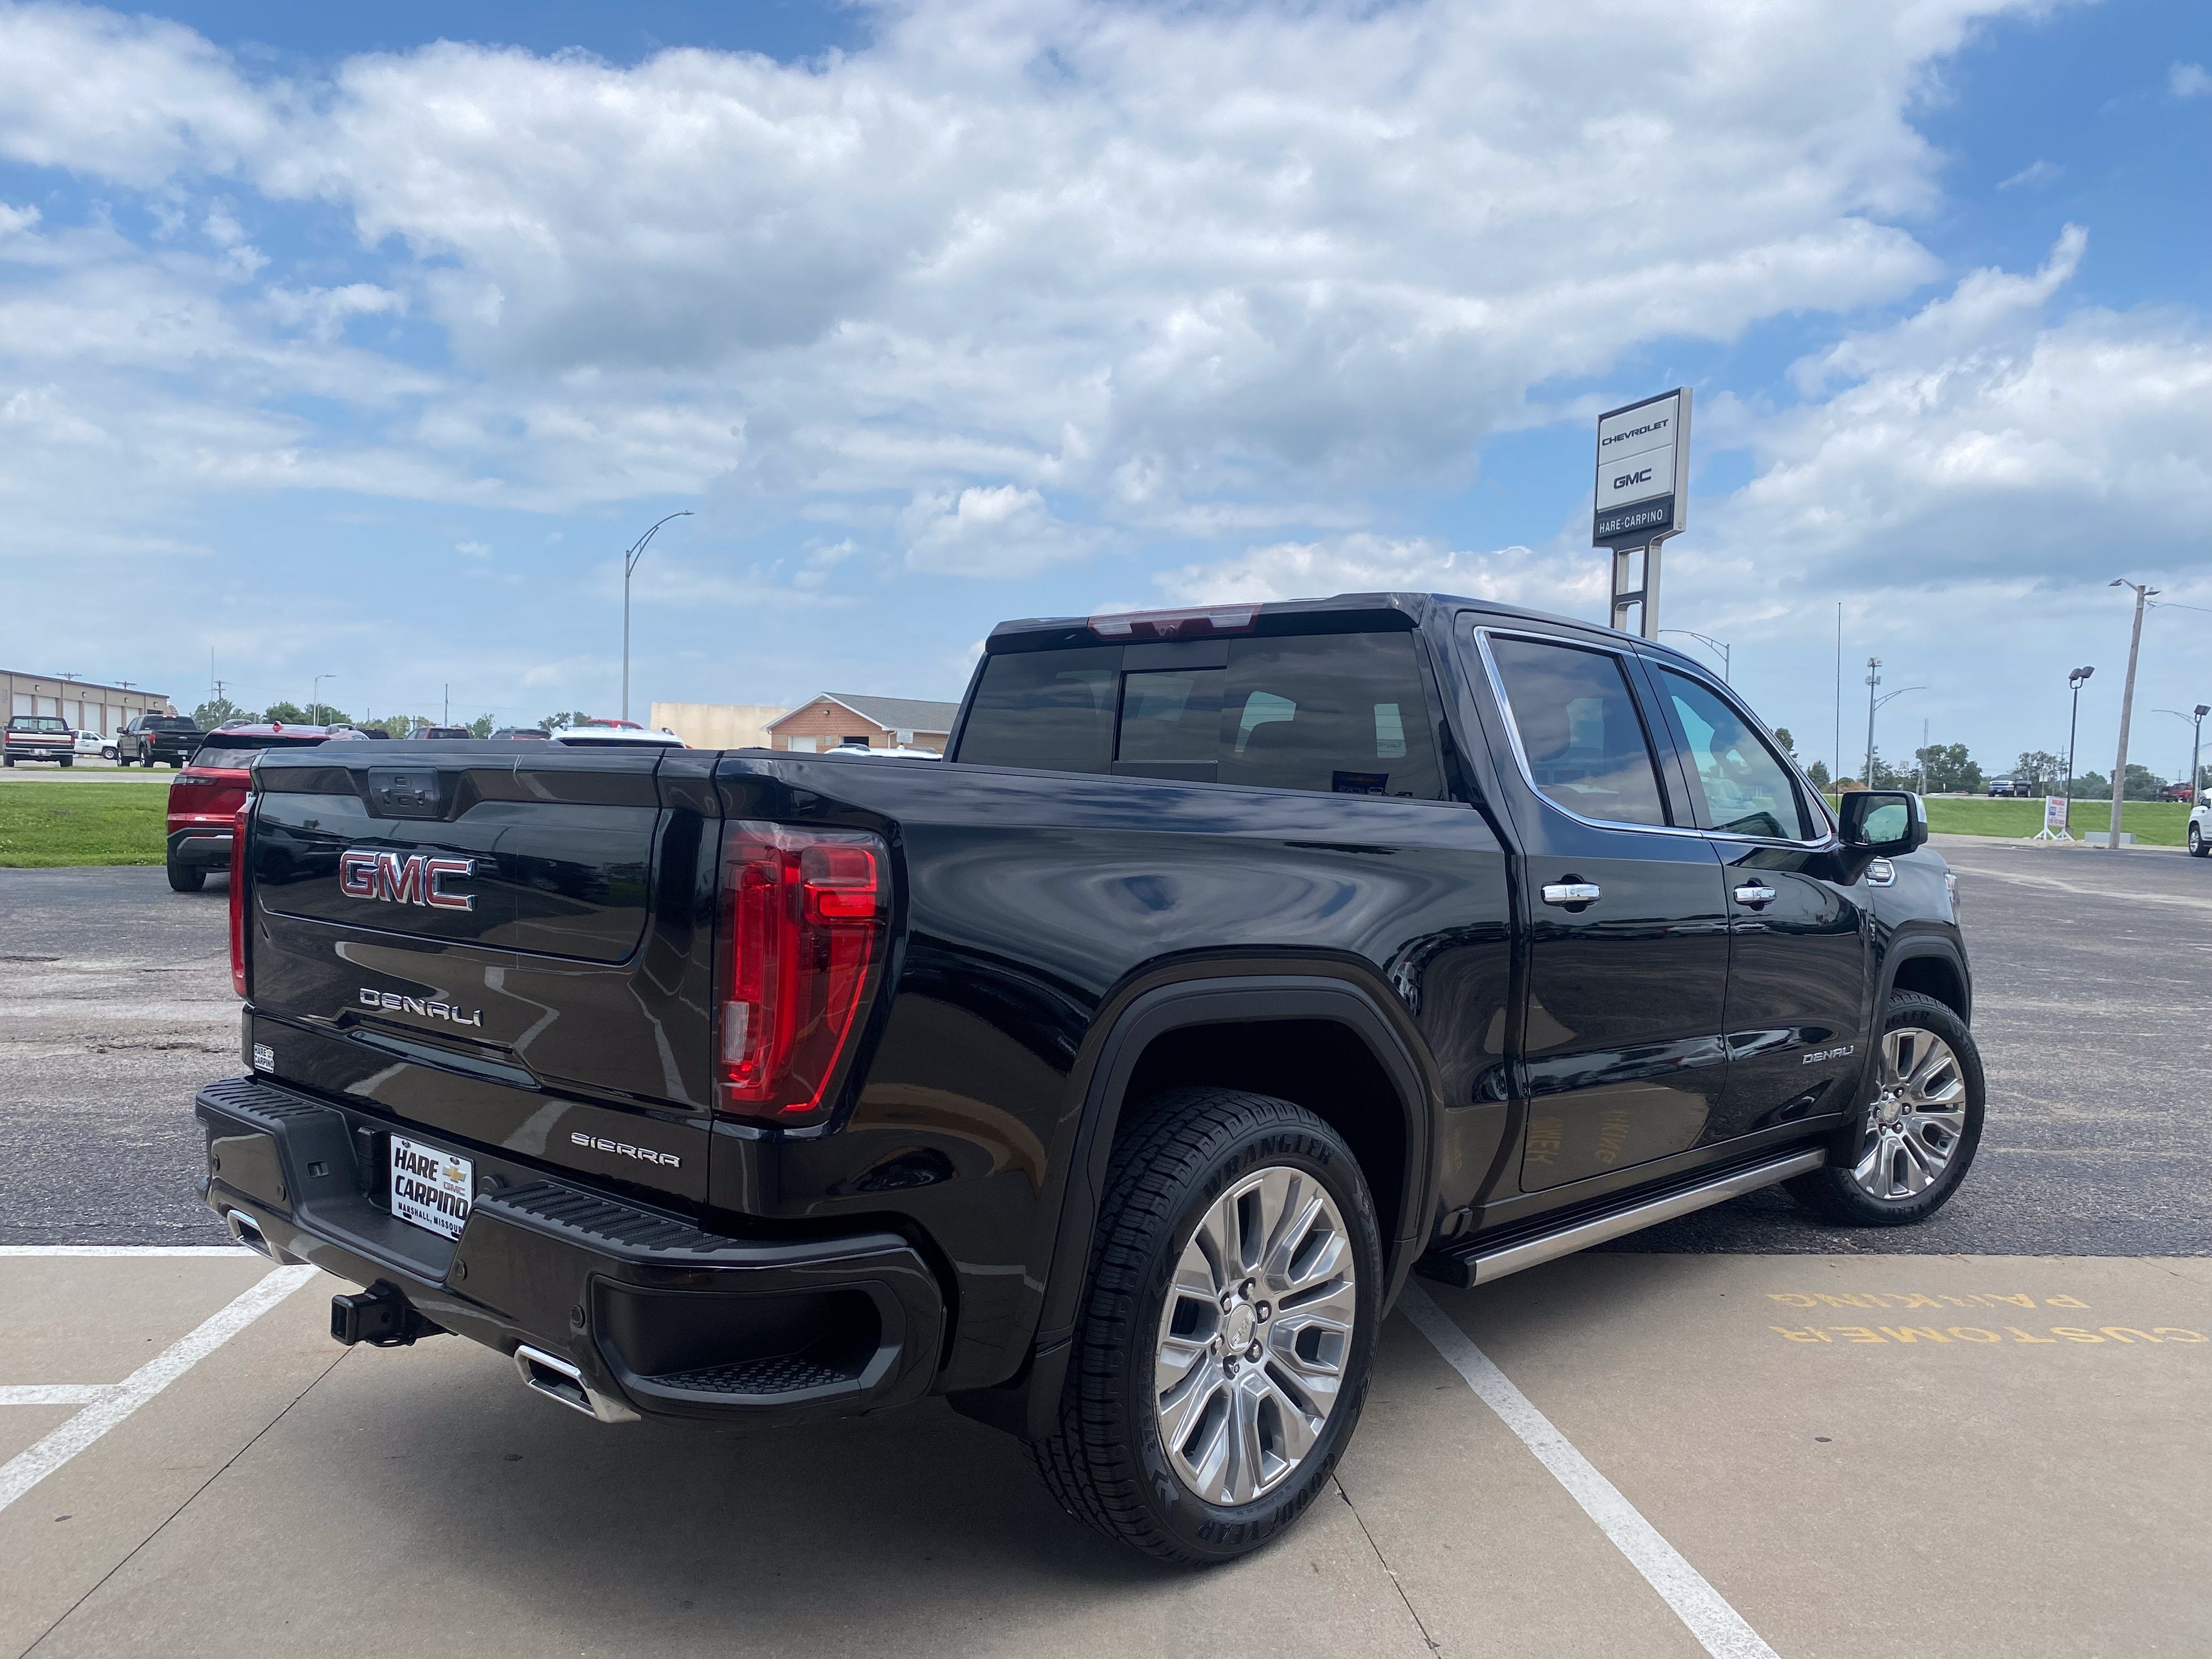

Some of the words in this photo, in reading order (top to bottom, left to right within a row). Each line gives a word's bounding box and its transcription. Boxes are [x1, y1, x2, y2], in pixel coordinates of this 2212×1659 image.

[1602, 419, 1669, 446] CHEVROLET
[1613, 468, 1652, 489] GMC
[1599, 509, 1663, 534] HARE-CARPINO
[340, 850, 478, 912] GMC
[359, 988, 483, 1027] DENALI
[1802, 1045, 1854, 1065] DENALI
[394, 1147, 439, 1182] HARE
[571, 1132, 680, 1168] SIERRA
[1202, 1133, 1333, 1198] WRANGLER
[395, 1175, 469, 1221] CARPINO
[443, 1181, 466, 1197] GMC
[398, 1201, 432, 1224] MARSHALL,
[433, 1216, 463, 1233] MISSOUR
[1769, 1325, 2209, 1344] CUSTOMER
[1198, 1453, 1335, 1544] GOODYEAR
